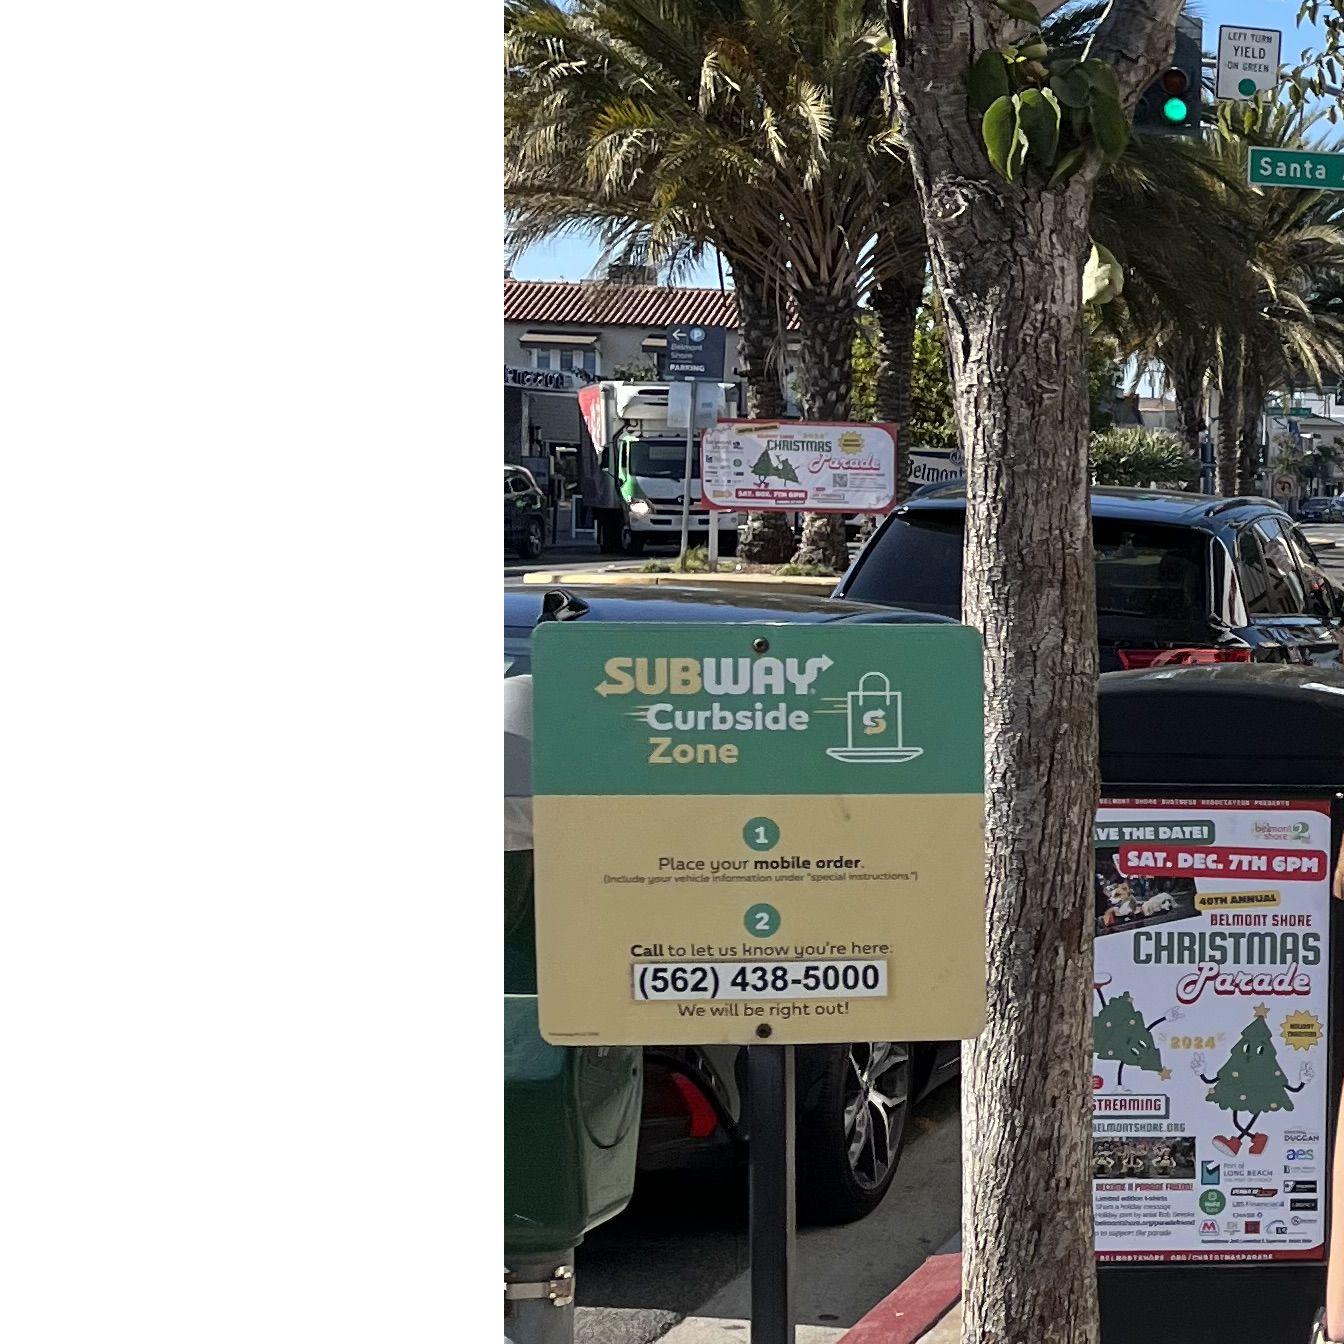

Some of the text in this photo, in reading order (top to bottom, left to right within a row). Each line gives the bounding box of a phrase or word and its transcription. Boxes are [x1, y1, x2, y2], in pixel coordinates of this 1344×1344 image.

[1227, 31, 1272, 44] LEFT TURN
[1233, 45, 1266, 60] YIELD
[1227, 61, 1270, 73] ON GREEN
[1259, 157, 1326, 179] Santa
[669, 364, 705, 373] PARKING
[767, 439, 832, 453] CHRISTMAS
[808, 455, 881, 474] Parade
[595, 654, 834, 698] SUBWAY
[646, 702, 810, 731] Curbside
[648, 737, 739, 765] Zone
[754, 826, 768, 843] 1
[1122, 827, 1154, 840] THE
[1158, 826, 1209, 840] DATE!
[658, 855, 864, 873] Place your mobile order.
[1127, 851, 1319, 873] SAT. DEC. 7TH 6PM
[1200, 894, 1277, 906] 40TH ANNUAL
[755, 912, 769, 929] 2
[1210, 914, 1312, 927] BELMONT SHORE
[630, 941, 894, 959] Call to let us know you're here:
[1133, 931, 1321, 965] CHRISTMAS
[638, 964, 880, 999] (562) 438-5000
[1176, 961, 1312, 1005] Parade
[678, 1001, 849, 1020] We will be right out!
[1170, 1036, 1216, 1049] 2024
[1092, 1099, 1162, 1111] STREAMING
[1286, 1149, 1314, 1160] aes
